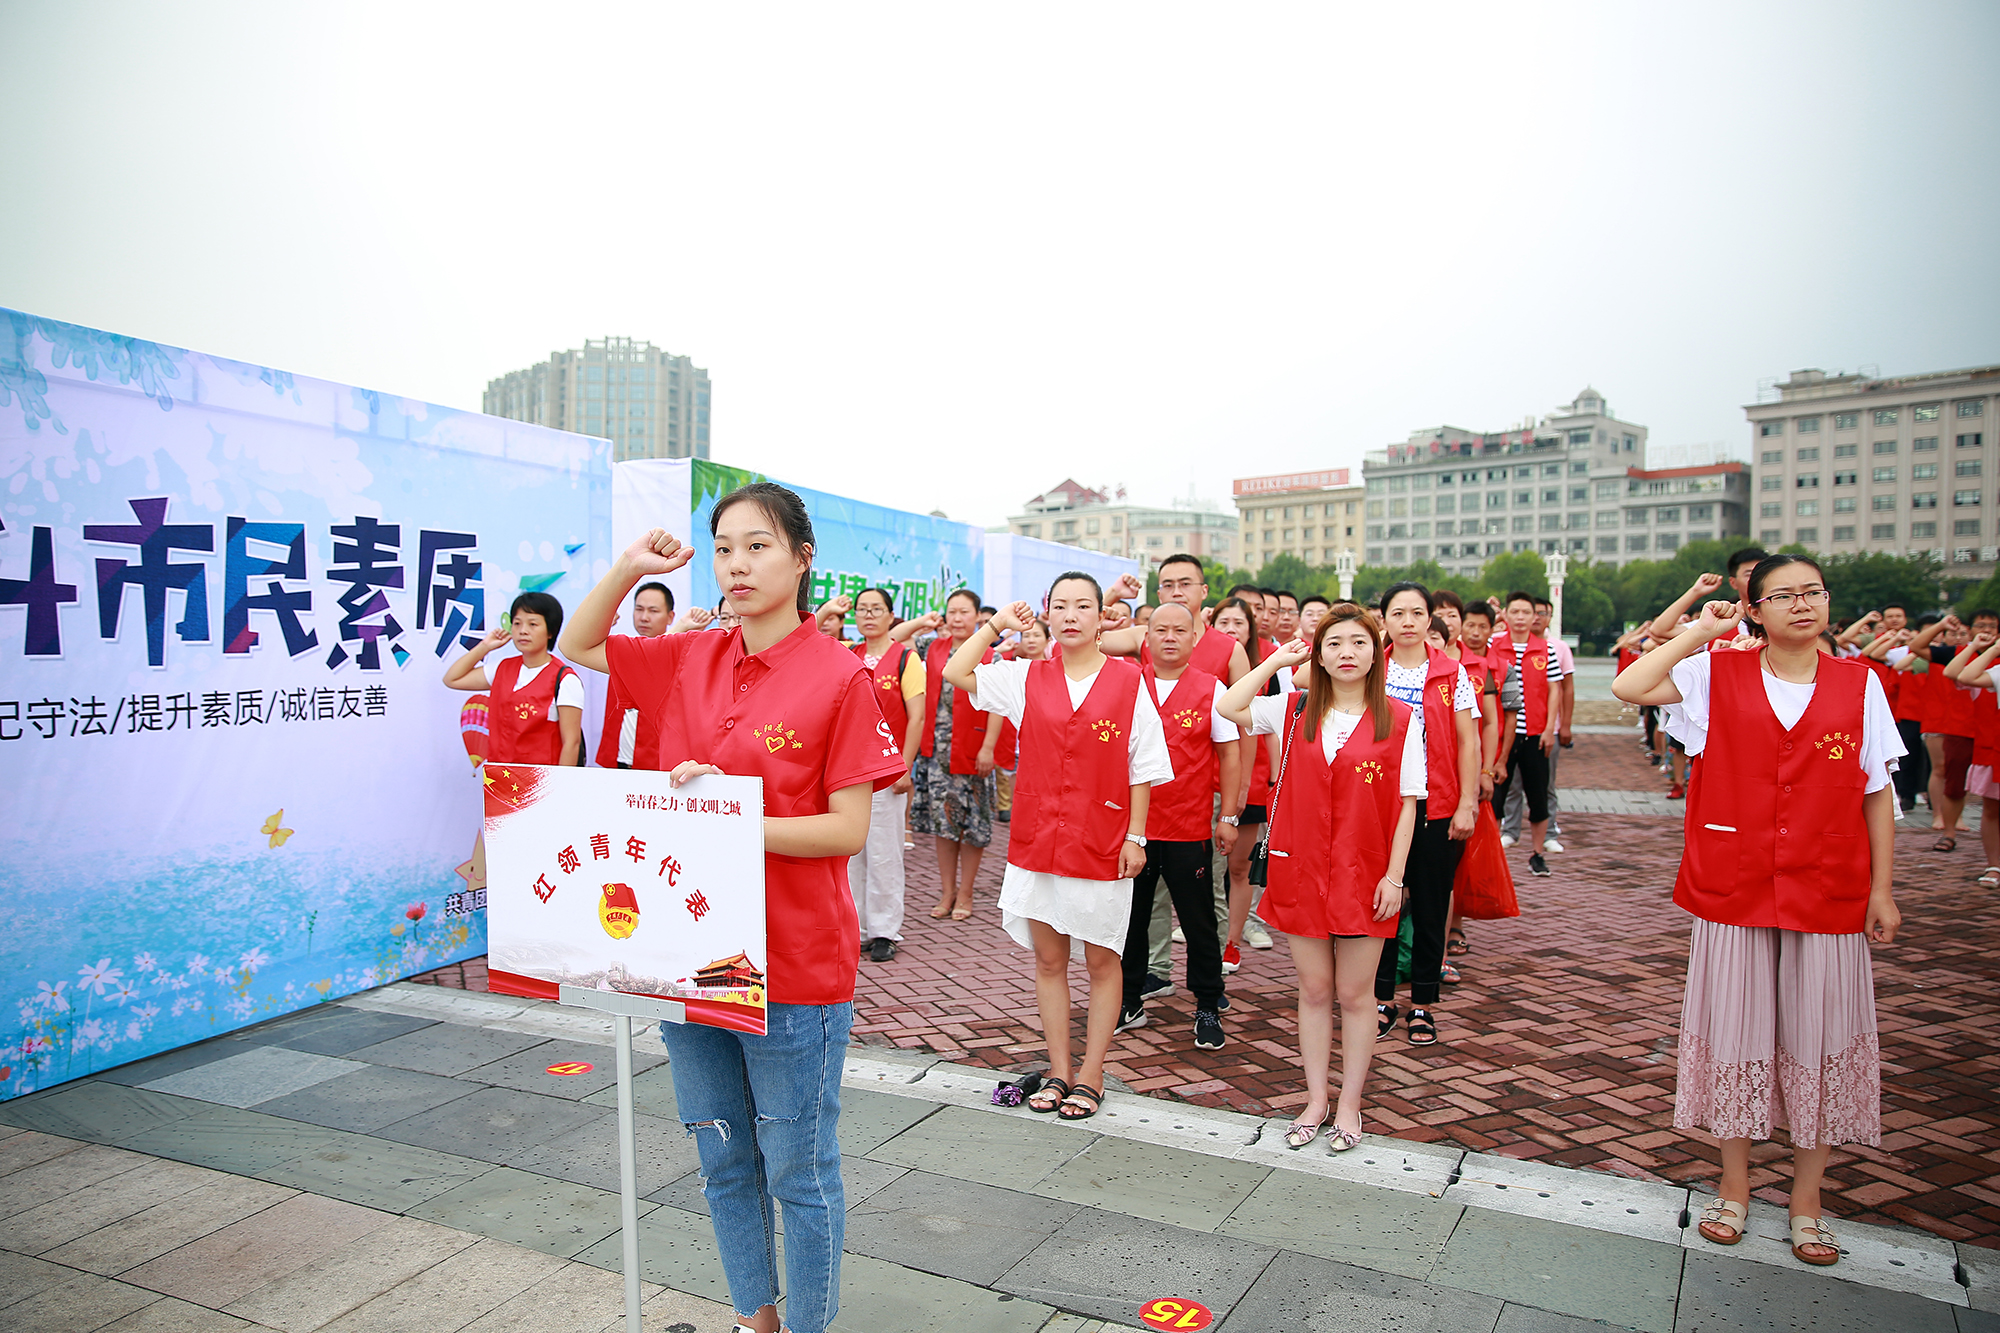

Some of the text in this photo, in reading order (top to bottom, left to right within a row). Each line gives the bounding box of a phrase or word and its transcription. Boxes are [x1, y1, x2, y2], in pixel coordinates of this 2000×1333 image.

[533, 833, 711, 922] 红领青年代表
[1143, 1301, 1200, 1328] 15
